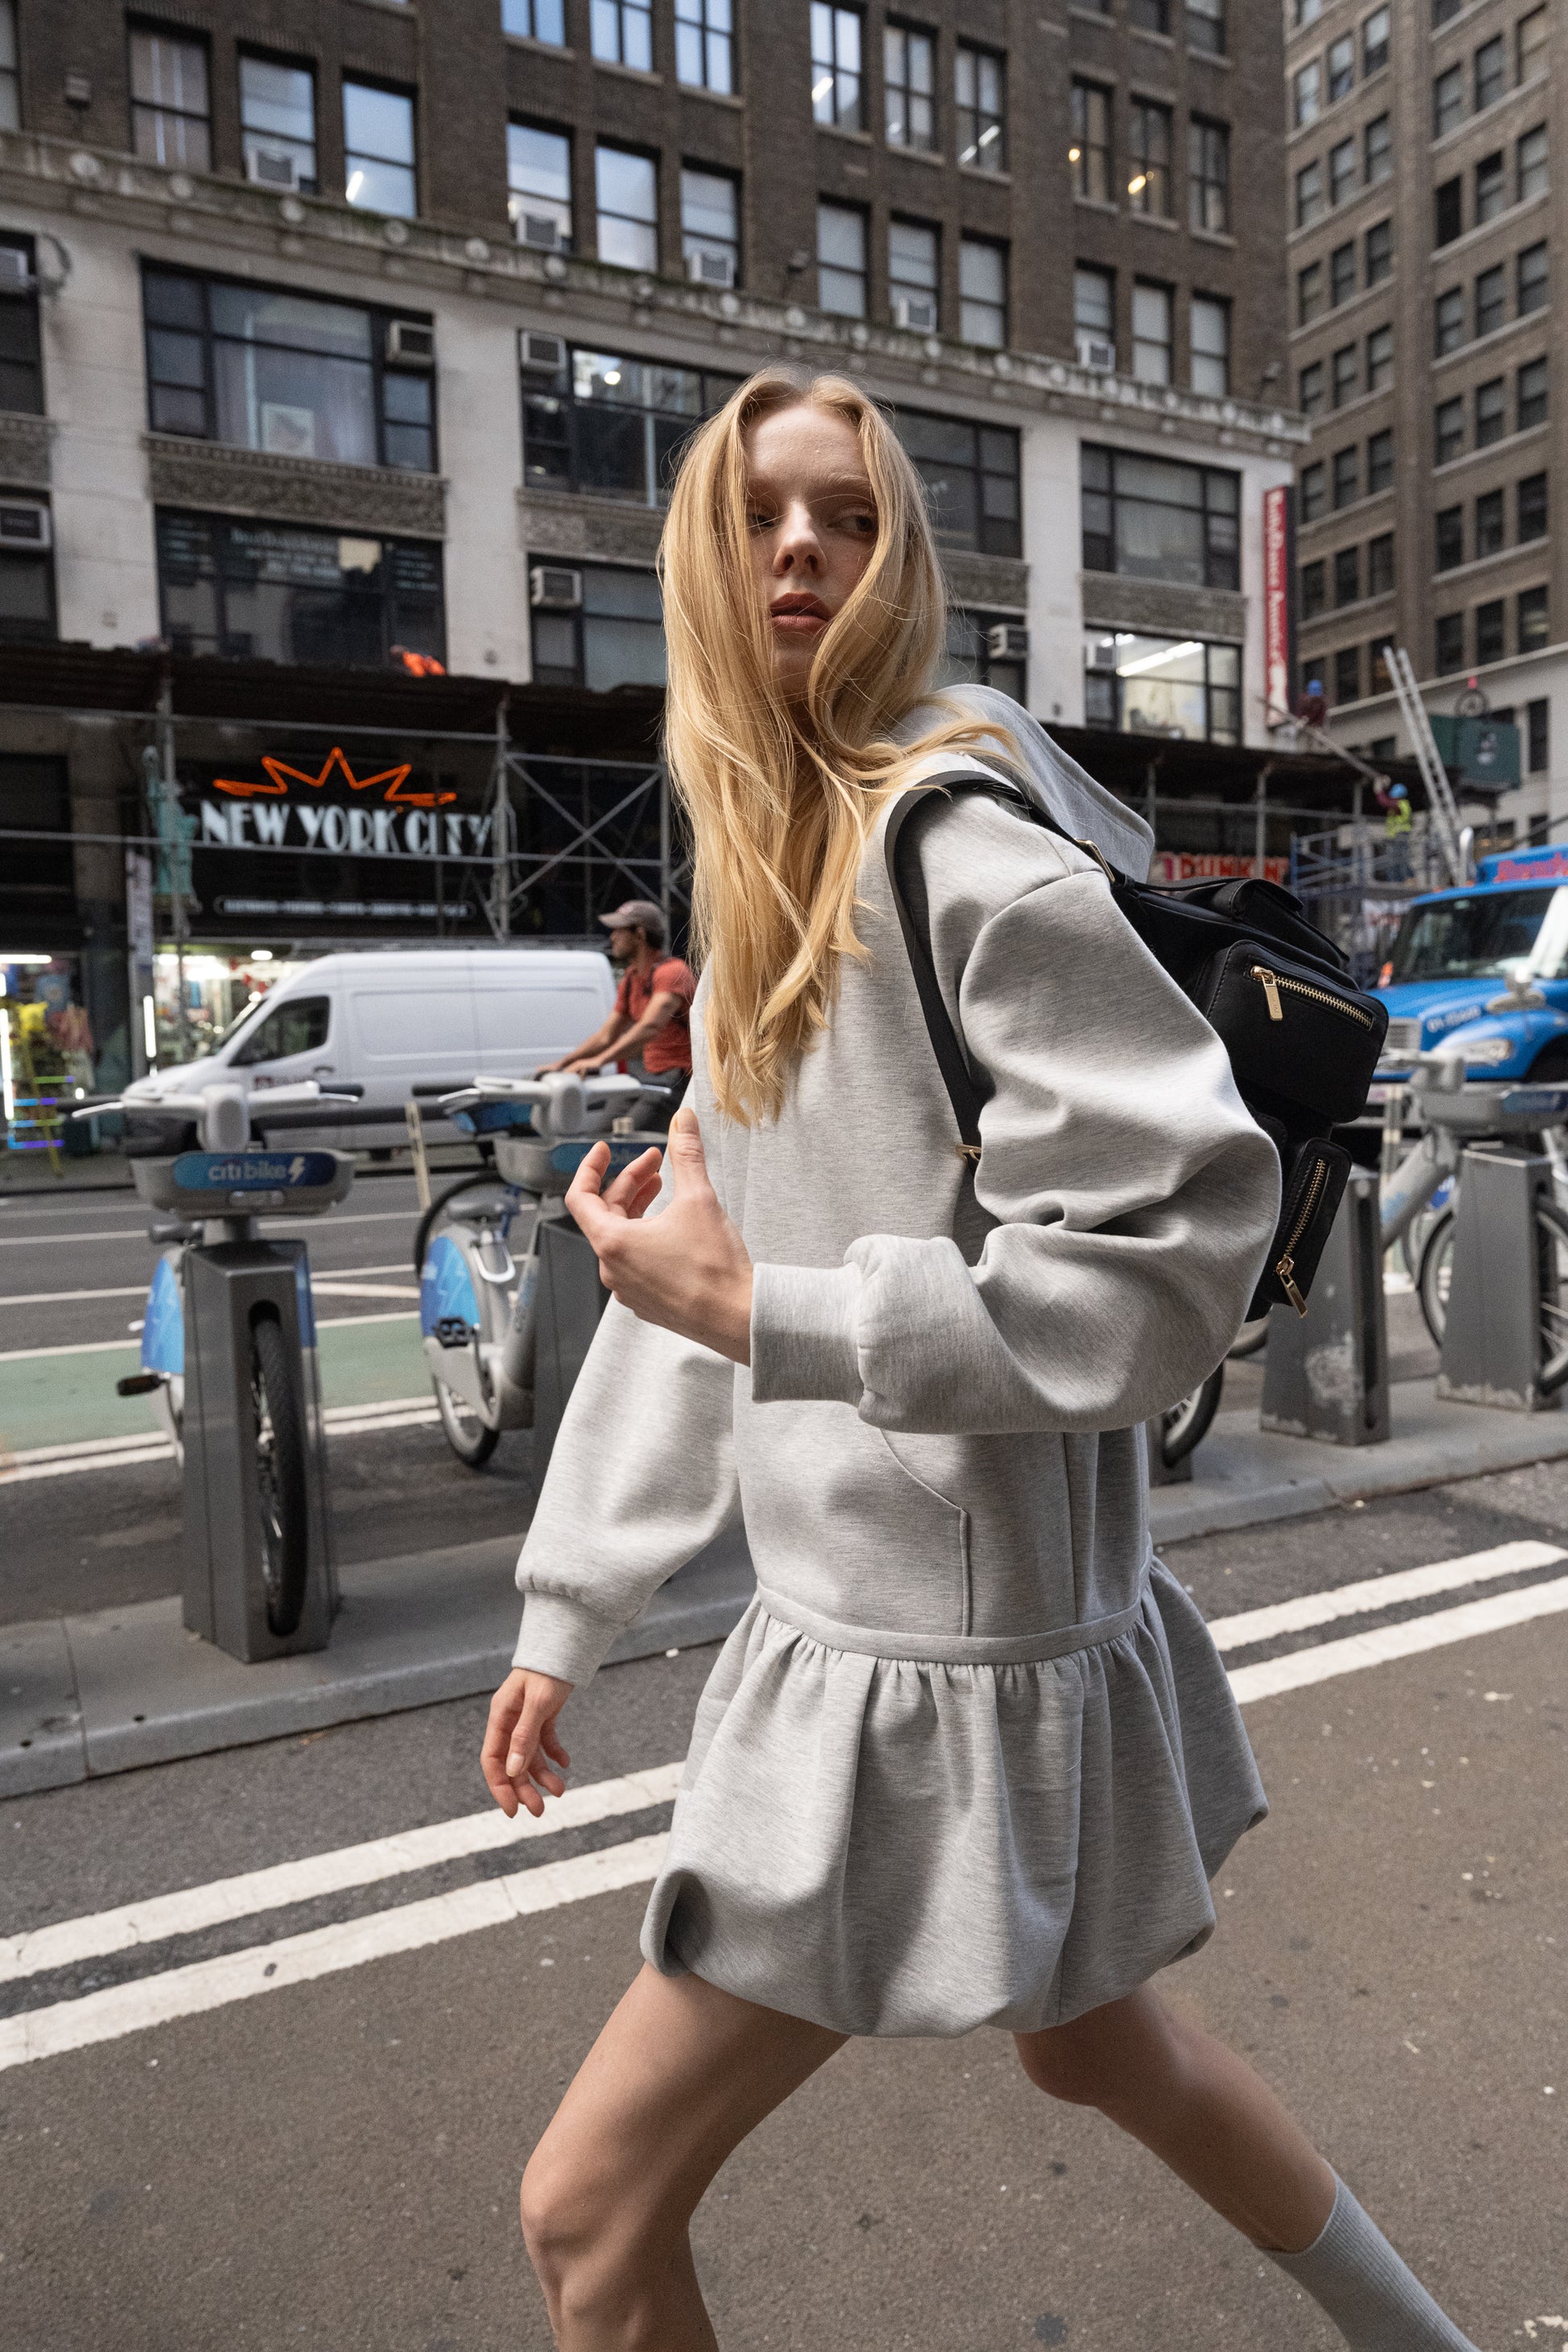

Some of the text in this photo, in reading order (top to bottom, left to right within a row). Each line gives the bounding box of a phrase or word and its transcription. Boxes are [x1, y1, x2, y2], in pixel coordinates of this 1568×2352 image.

[201, 800, 492, 856] NEW YORK CITY
